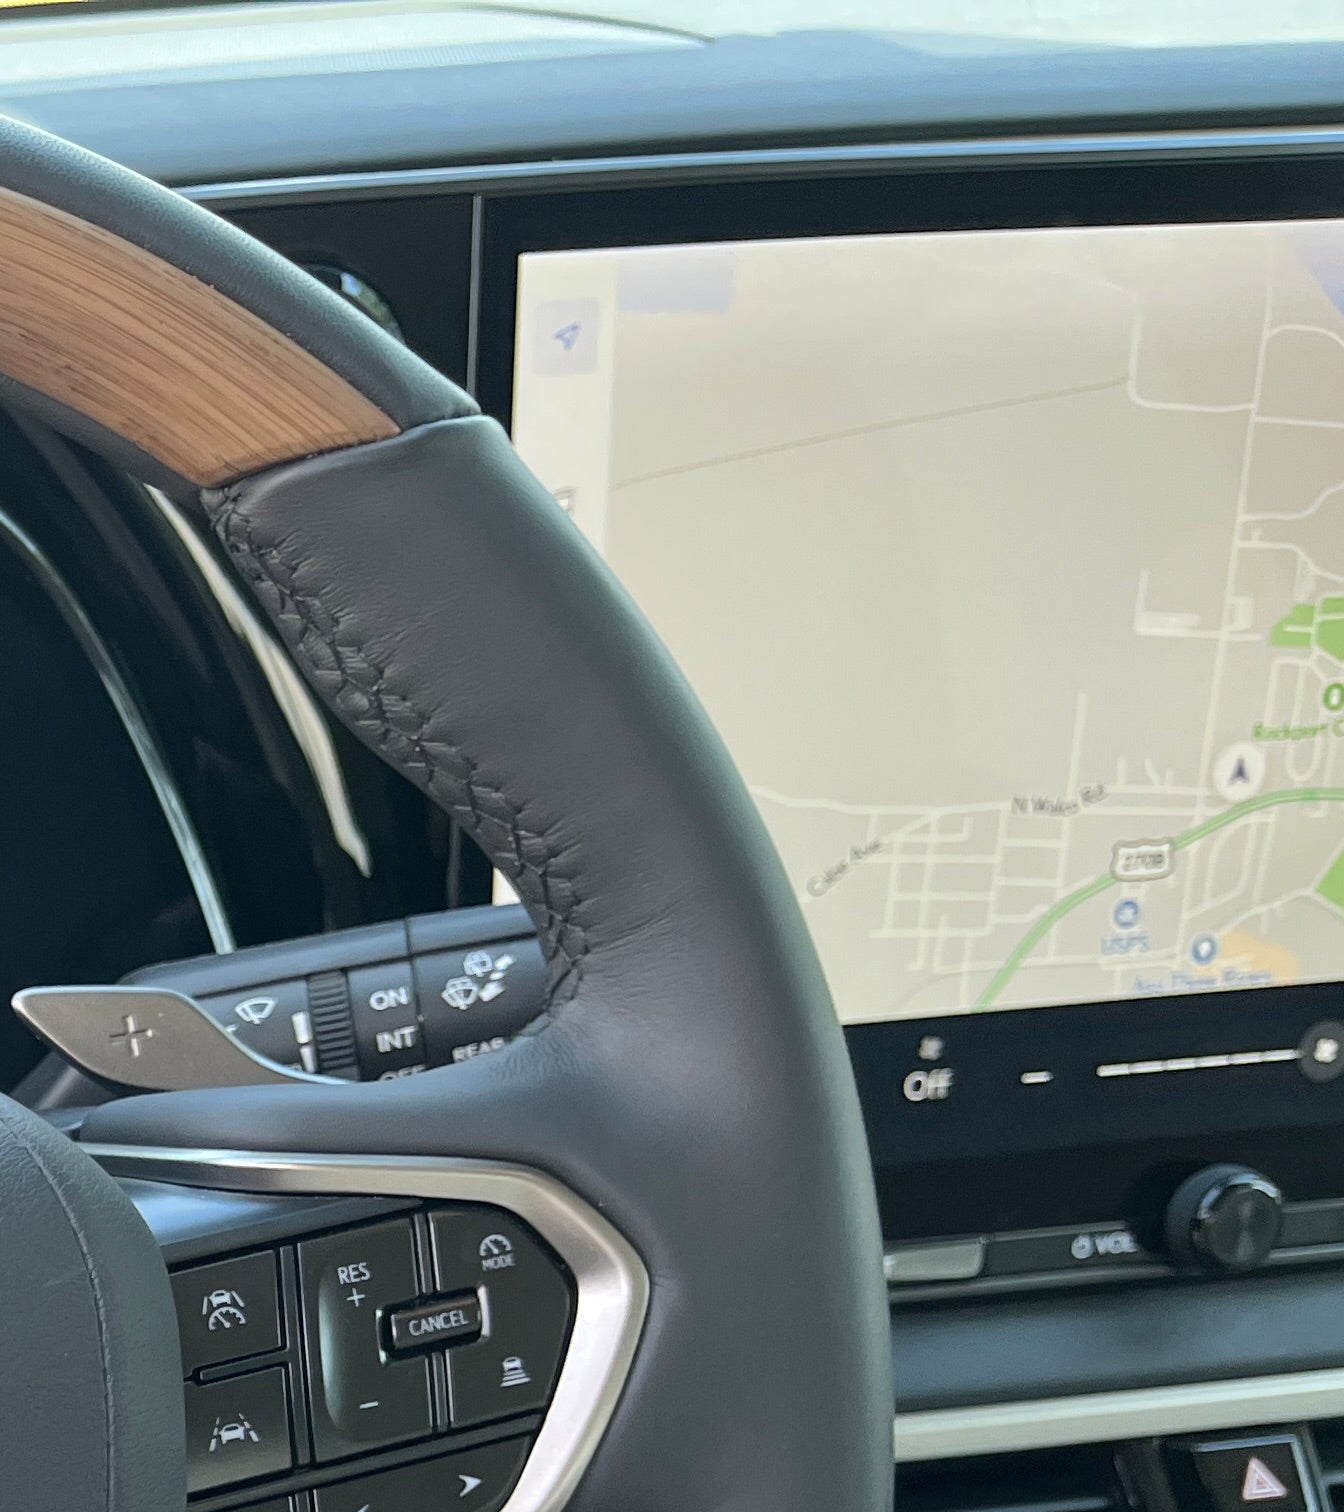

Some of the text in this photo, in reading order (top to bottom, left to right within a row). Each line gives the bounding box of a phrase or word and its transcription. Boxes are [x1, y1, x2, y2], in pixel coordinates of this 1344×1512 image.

[369, 987, 408, 1011] ON
[376, 1025, 418, 1054] INT
[903, 1067, 954, 1102] Off
[337, 1262, 371, 1285] RES
[481, 1252, 515, 1271] MODE
[408, 1308, 469, 1337] CANCEL
